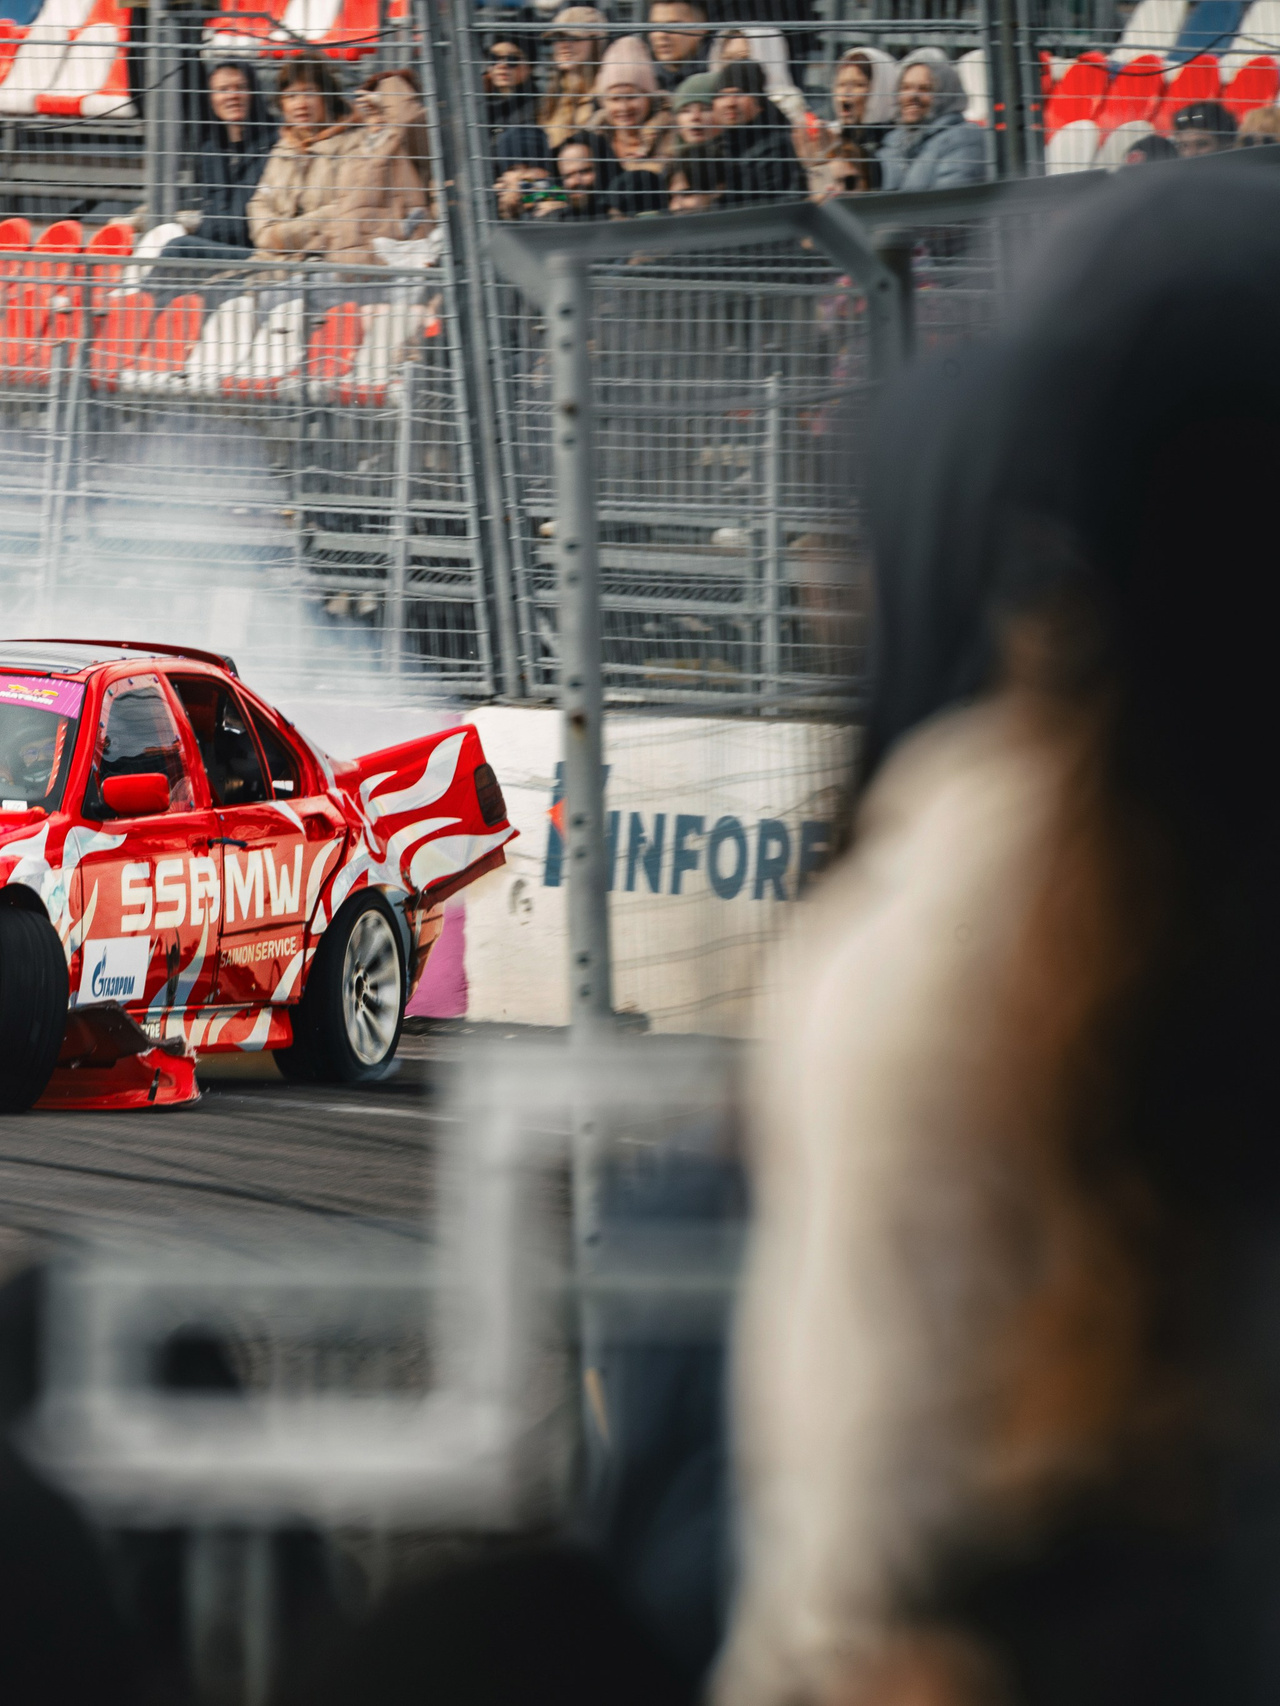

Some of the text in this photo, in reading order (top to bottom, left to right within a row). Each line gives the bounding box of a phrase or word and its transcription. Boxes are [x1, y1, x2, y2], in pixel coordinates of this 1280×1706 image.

[121, 844, 304, 932] SSBMW
[220, 936, 297, 967] SAIMON SERVICE
[102, 976, 136, 996] ГАЗПРОМ
